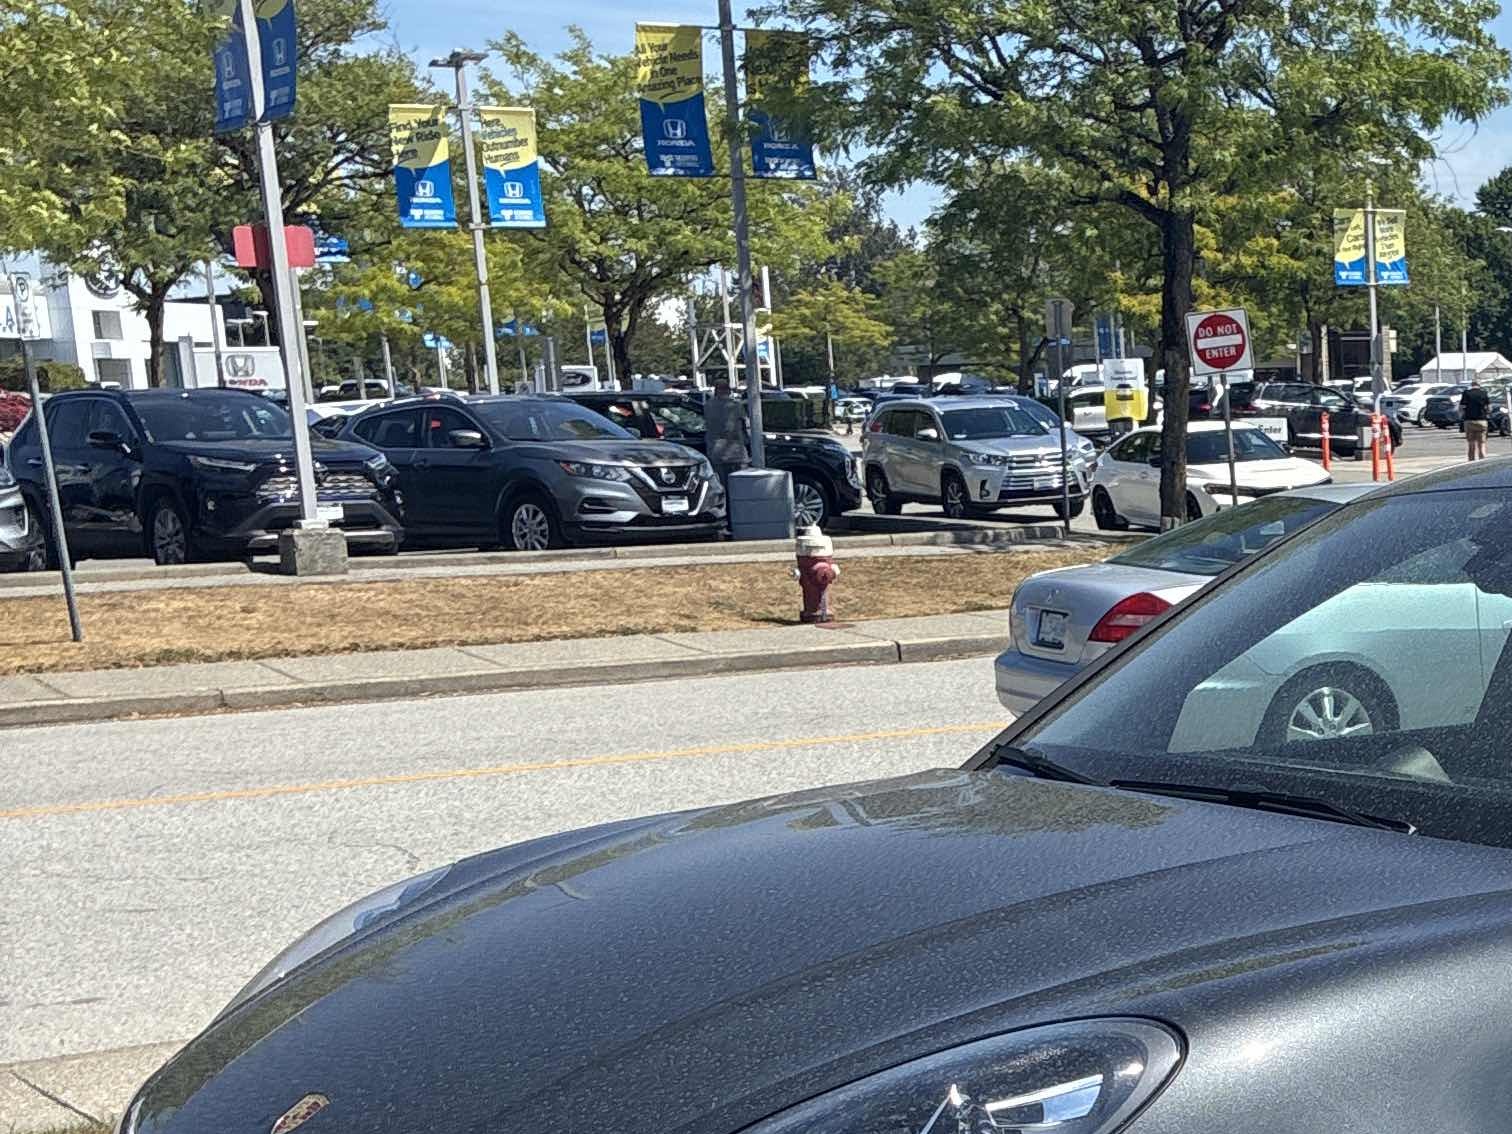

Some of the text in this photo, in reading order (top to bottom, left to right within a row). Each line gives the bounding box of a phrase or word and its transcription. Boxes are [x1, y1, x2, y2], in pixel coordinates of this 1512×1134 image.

[1198, 323, 1238, 338] DO NOT
[1205, 346, 1237, 359] ENTER
